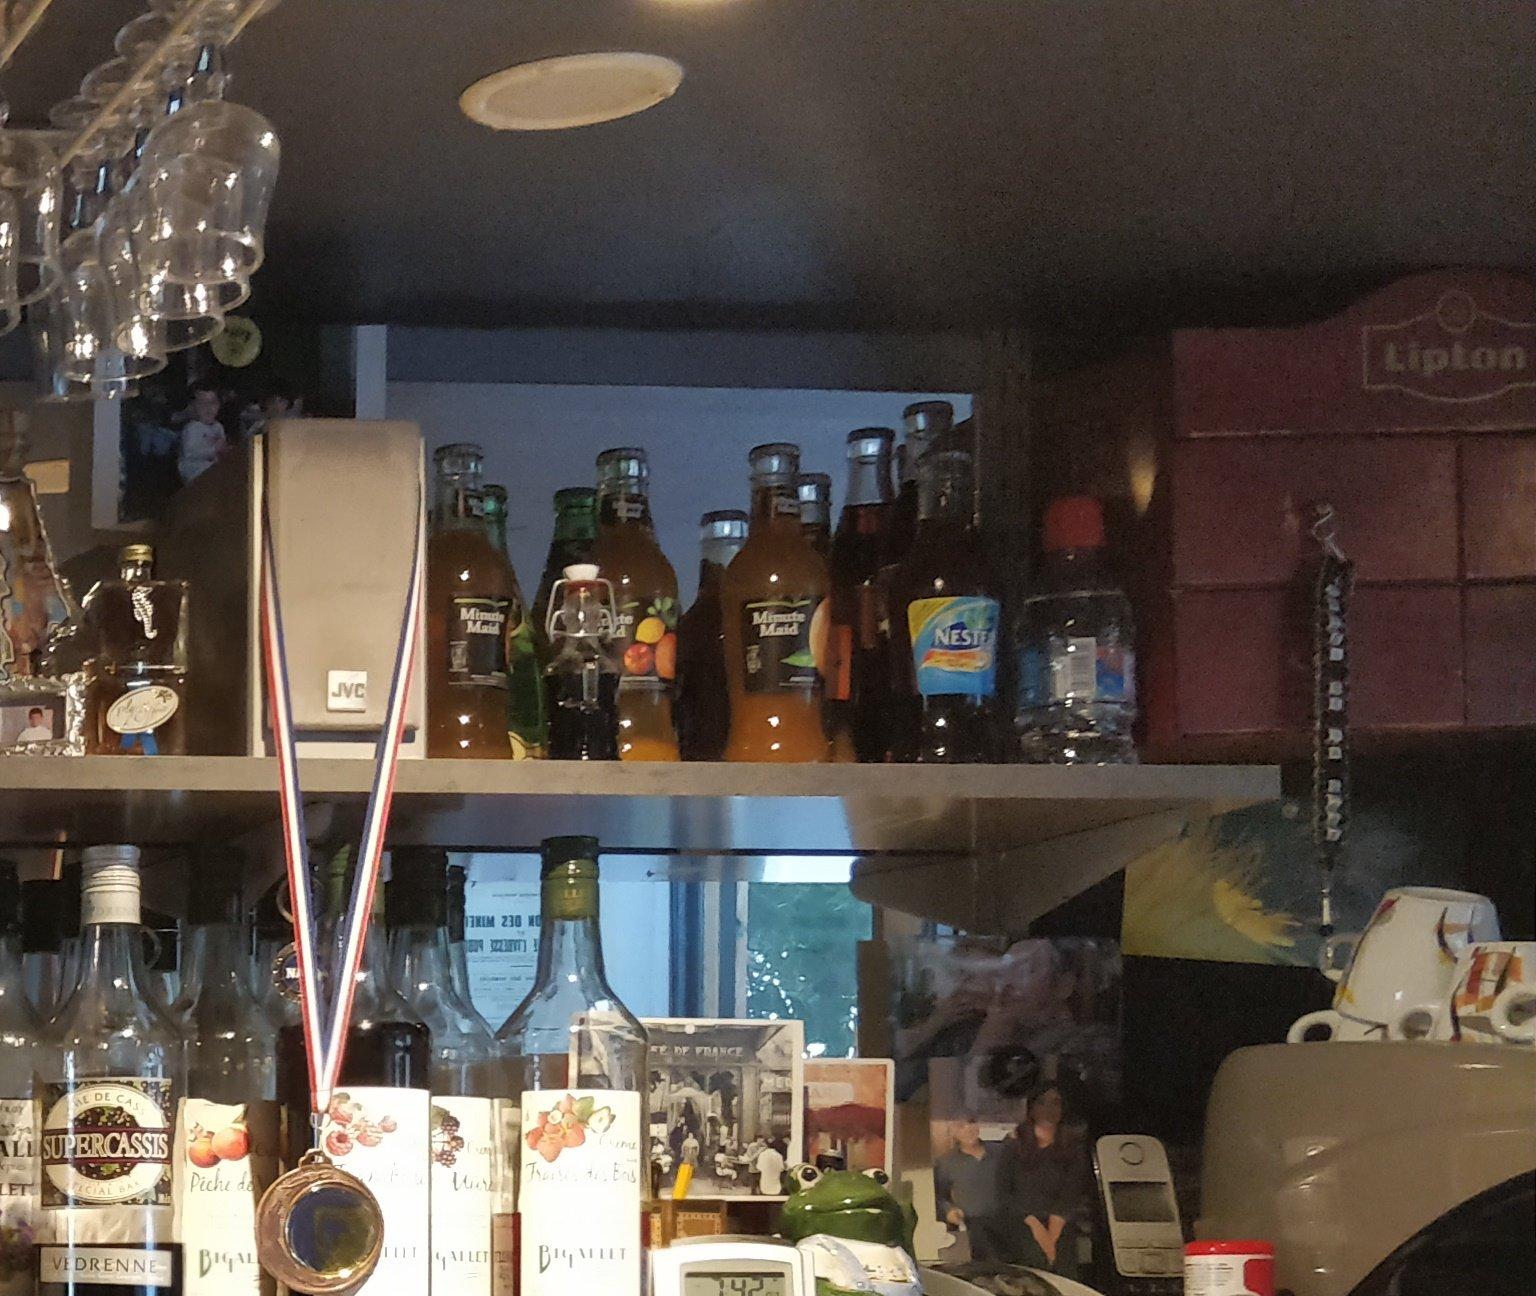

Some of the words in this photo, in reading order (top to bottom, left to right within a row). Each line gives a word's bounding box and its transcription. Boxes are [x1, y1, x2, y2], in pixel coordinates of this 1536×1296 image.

[1384, 341, 1527, 376] Lipton
[460, 607, 505, 624] Minute
[752, 611, 806, 625] Minute
[466, 621, 500, 636] Maid
[759, 622, 799, 637] Maid
[331, 683, 365, 699] JVC
[43, 1131, 170, 1160] SUPERCASSIS
